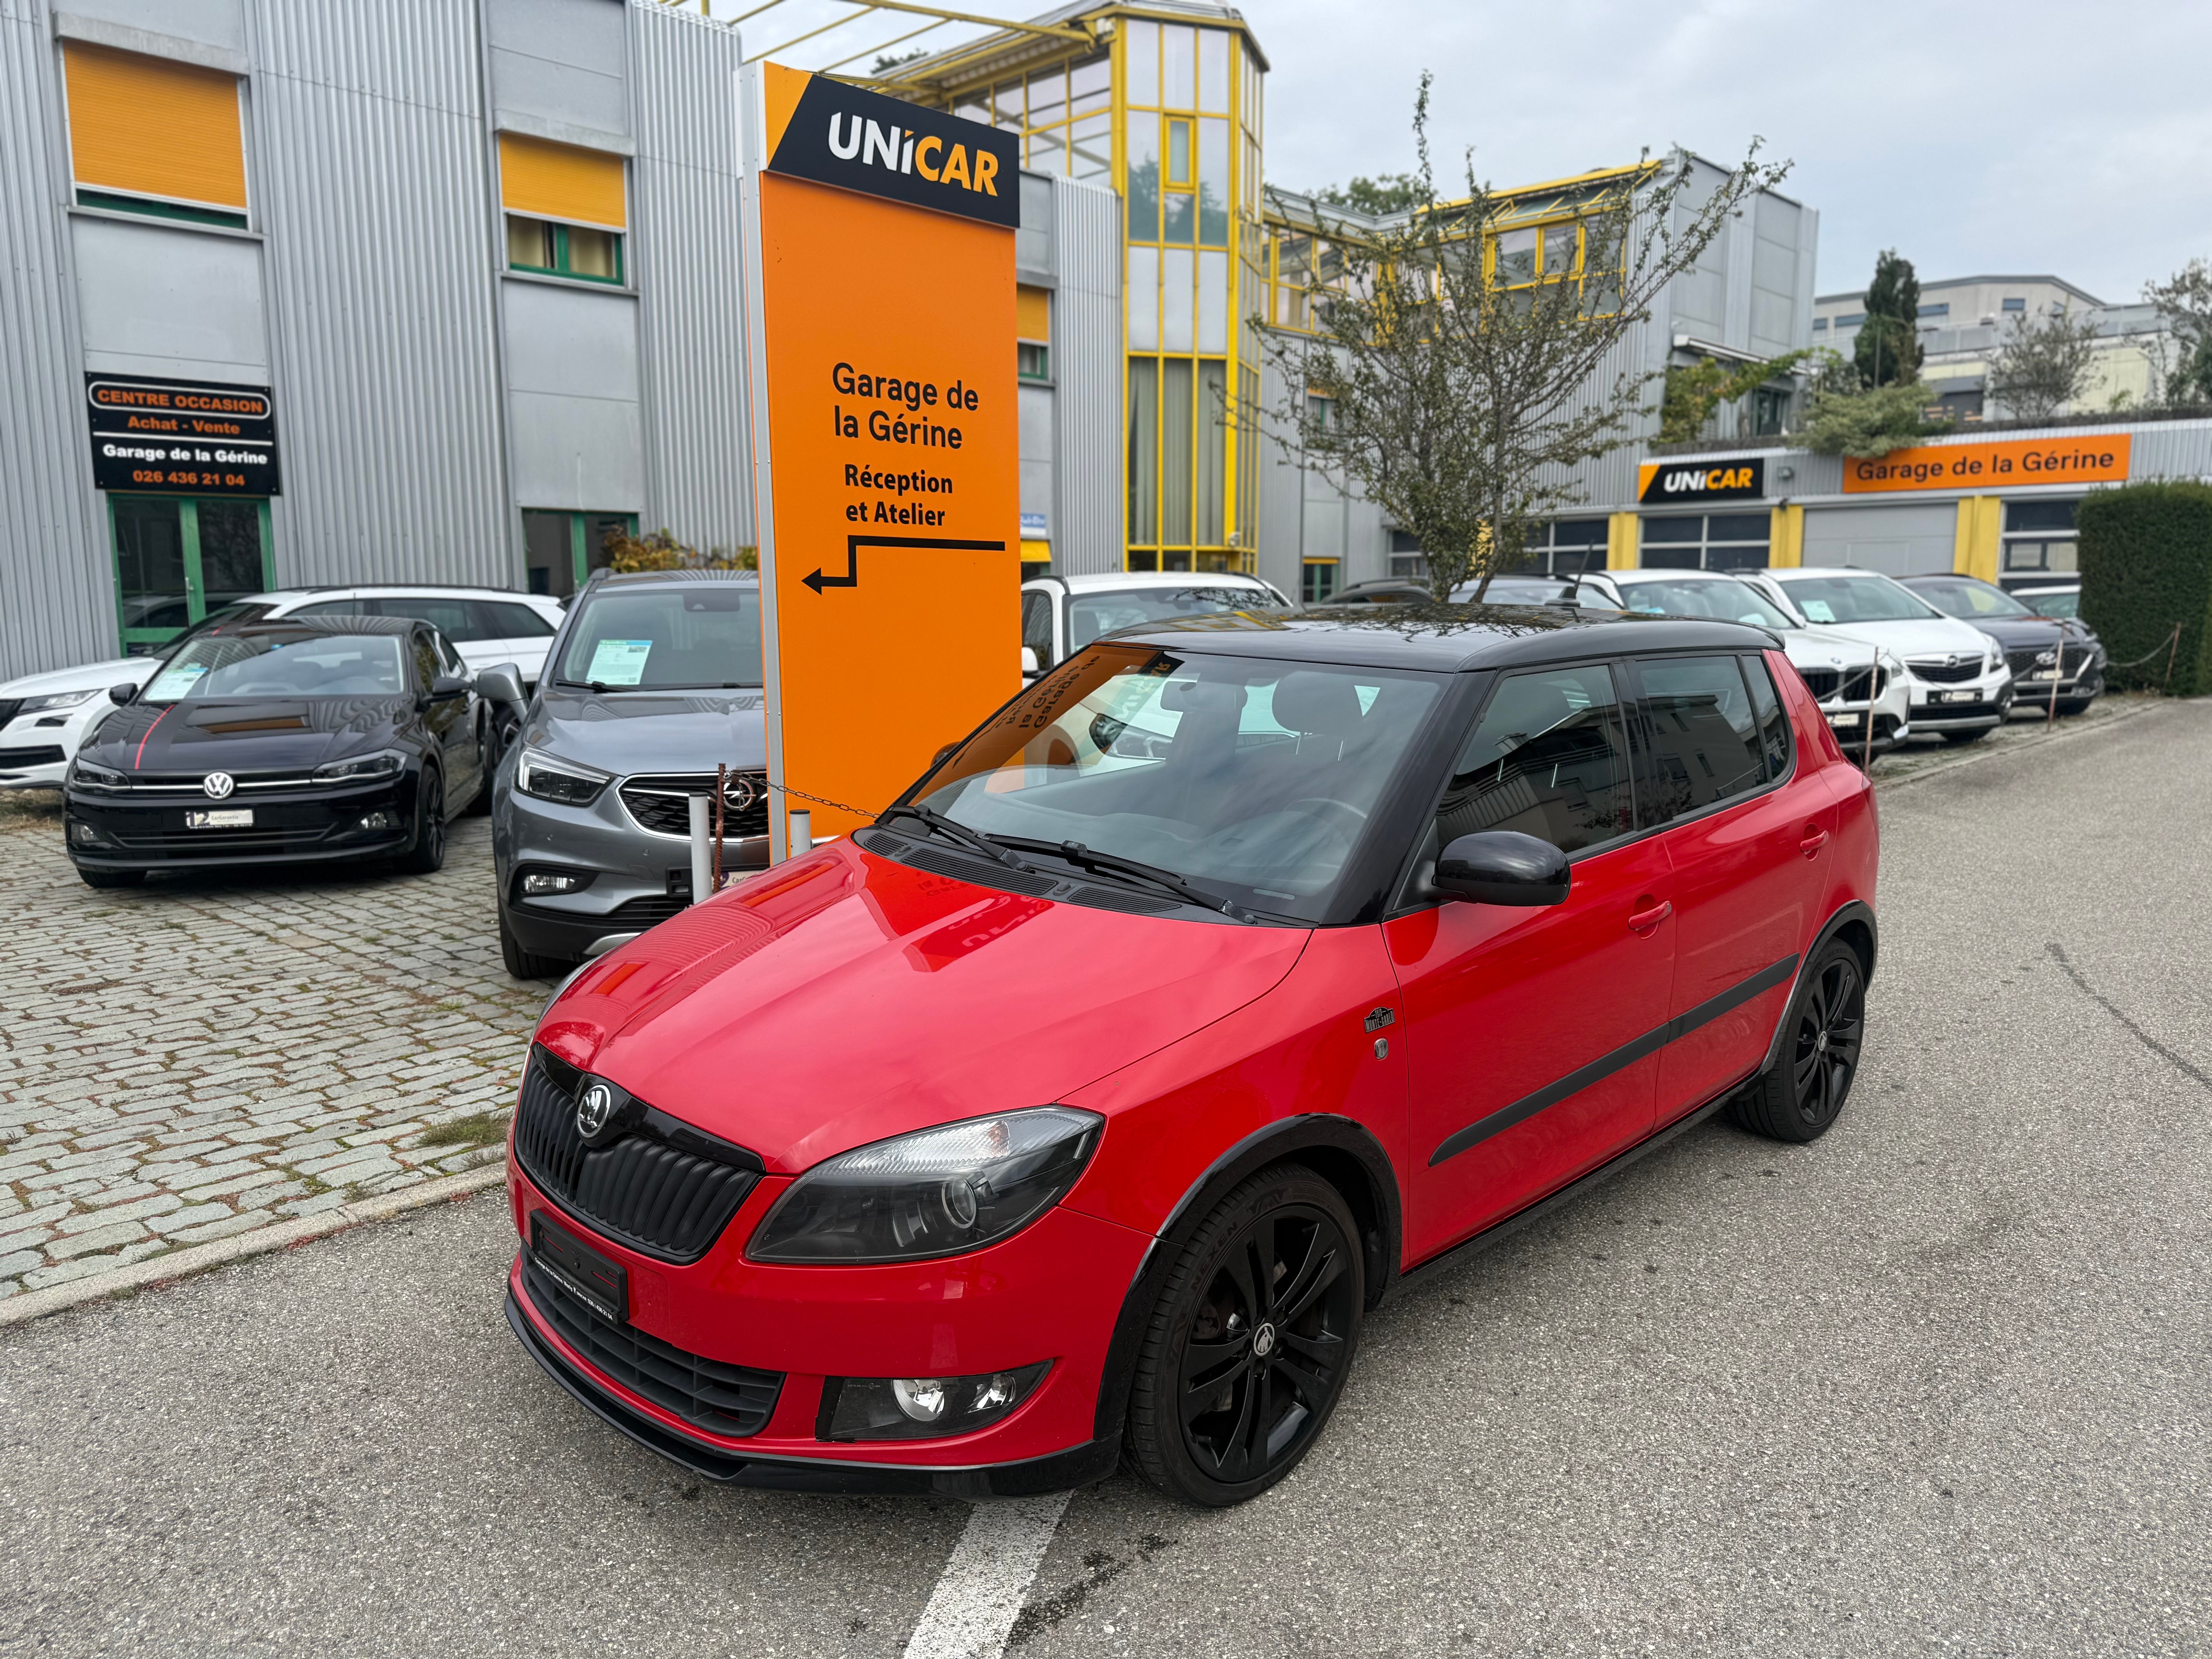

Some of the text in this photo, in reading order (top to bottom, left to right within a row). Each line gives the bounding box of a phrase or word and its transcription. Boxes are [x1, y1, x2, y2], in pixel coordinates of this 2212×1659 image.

[97, 389, 263, 413] CENTRE OCCASION
[832, 362, 979, 412] Garage de
[127, 416, 178, 431] Achat
[192, 420, 240, 434] Vente
[834, 405, 963, 449] la Gérine
[103, 444, 268, 464] Garage de la Gérine
[1857, 449, 2114, 483] Garage de la Gérine
[133, 470, 245, 486] 026 436 21 04
[845, 464, 953, 496] Réception
[846, 501, 945, 526] et Atelier
[1191, 1221, 1238, 1291] NEXEN
